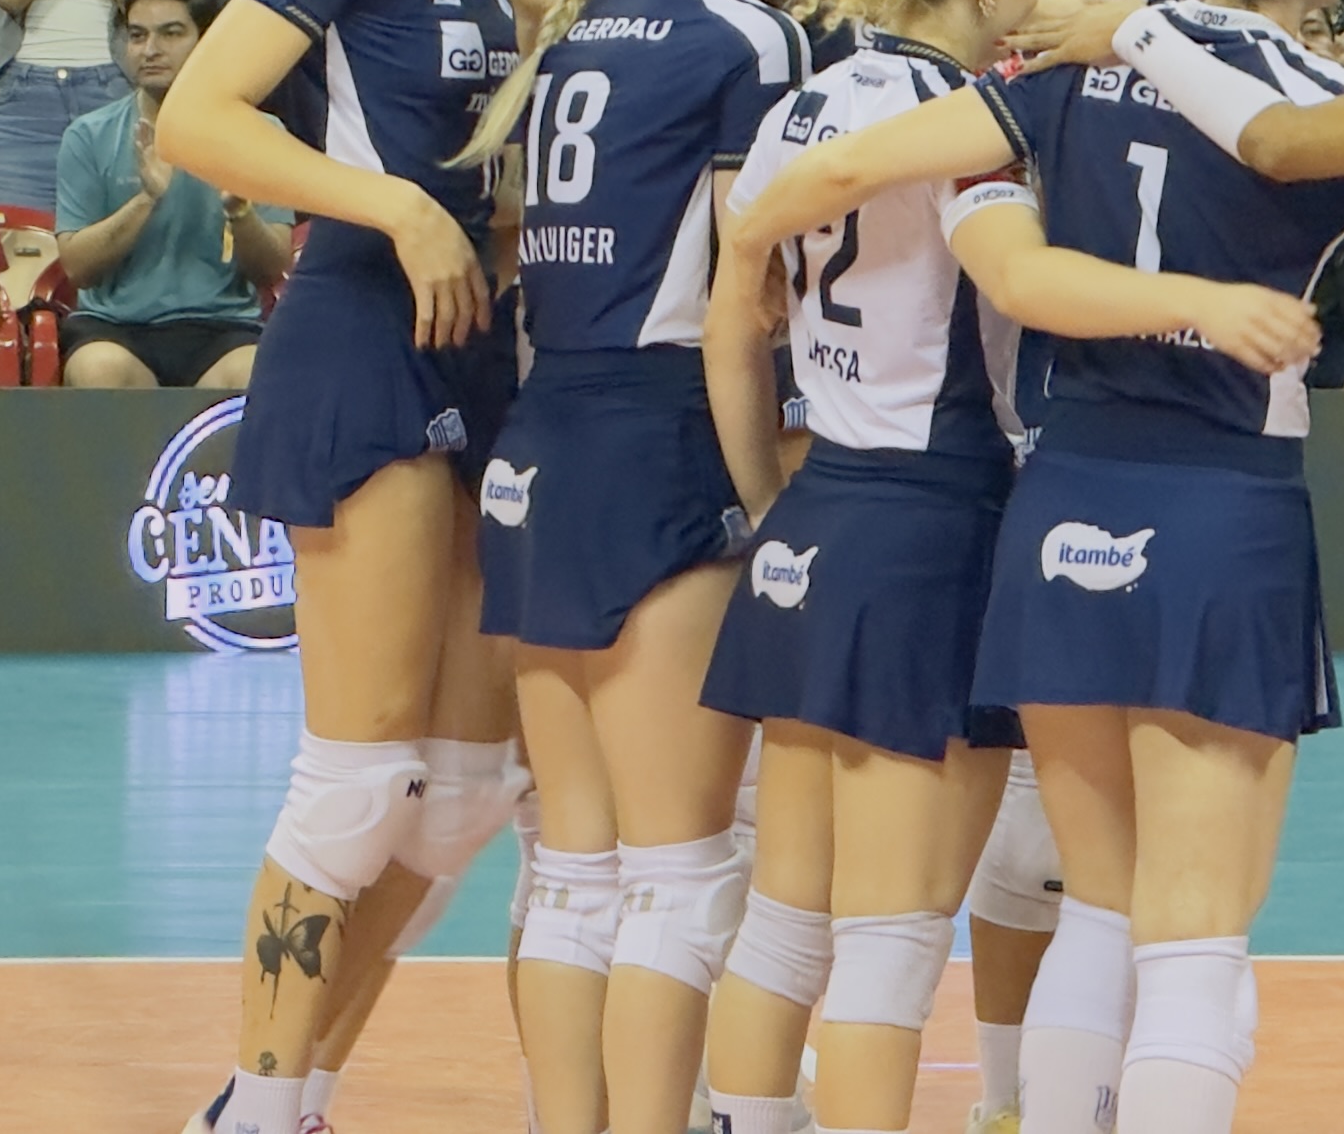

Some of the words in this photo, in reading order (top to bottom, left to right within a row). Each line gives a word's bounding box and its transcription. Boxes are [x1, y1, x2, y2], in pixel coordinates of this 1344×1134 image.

[567, 17, 673, 42] GERDAU
[524, 70, 611, 207] 18
[1126, 141, 1169, 274] 1
[1058, 543, 1135, 567] itambé
[187, 574, 284, 609] PRODU
